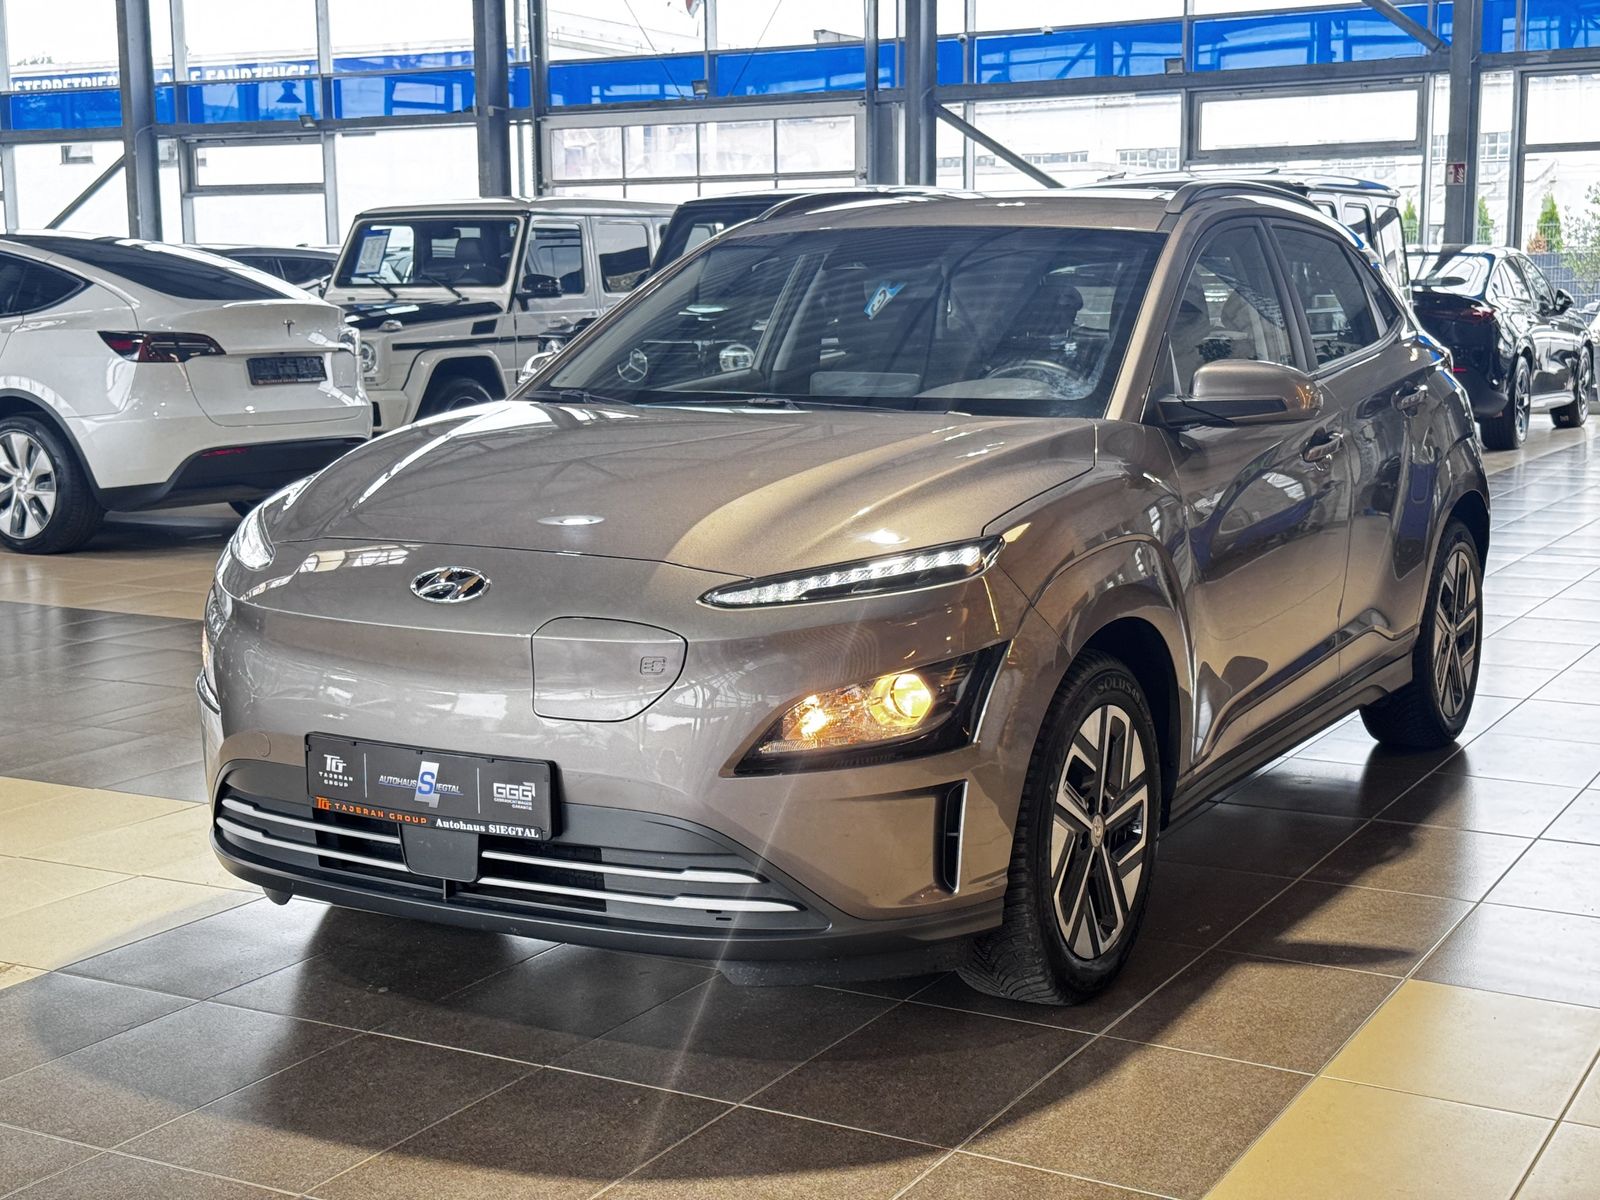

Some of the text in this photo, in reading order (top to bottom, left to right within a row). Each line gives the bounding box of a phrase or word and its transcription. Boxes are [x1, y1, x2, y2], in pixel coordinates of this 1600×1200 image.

[323, 779, 349, 788] GROUP
[378, 774, 418, 788] AUTOHAUS
[493, 781, 535, 801] GGG
[388, 812, 428, 825] GROUP
[435, 817, 486, 834] Autohaus
[488, 823, 540, 839] SIEGTAL
